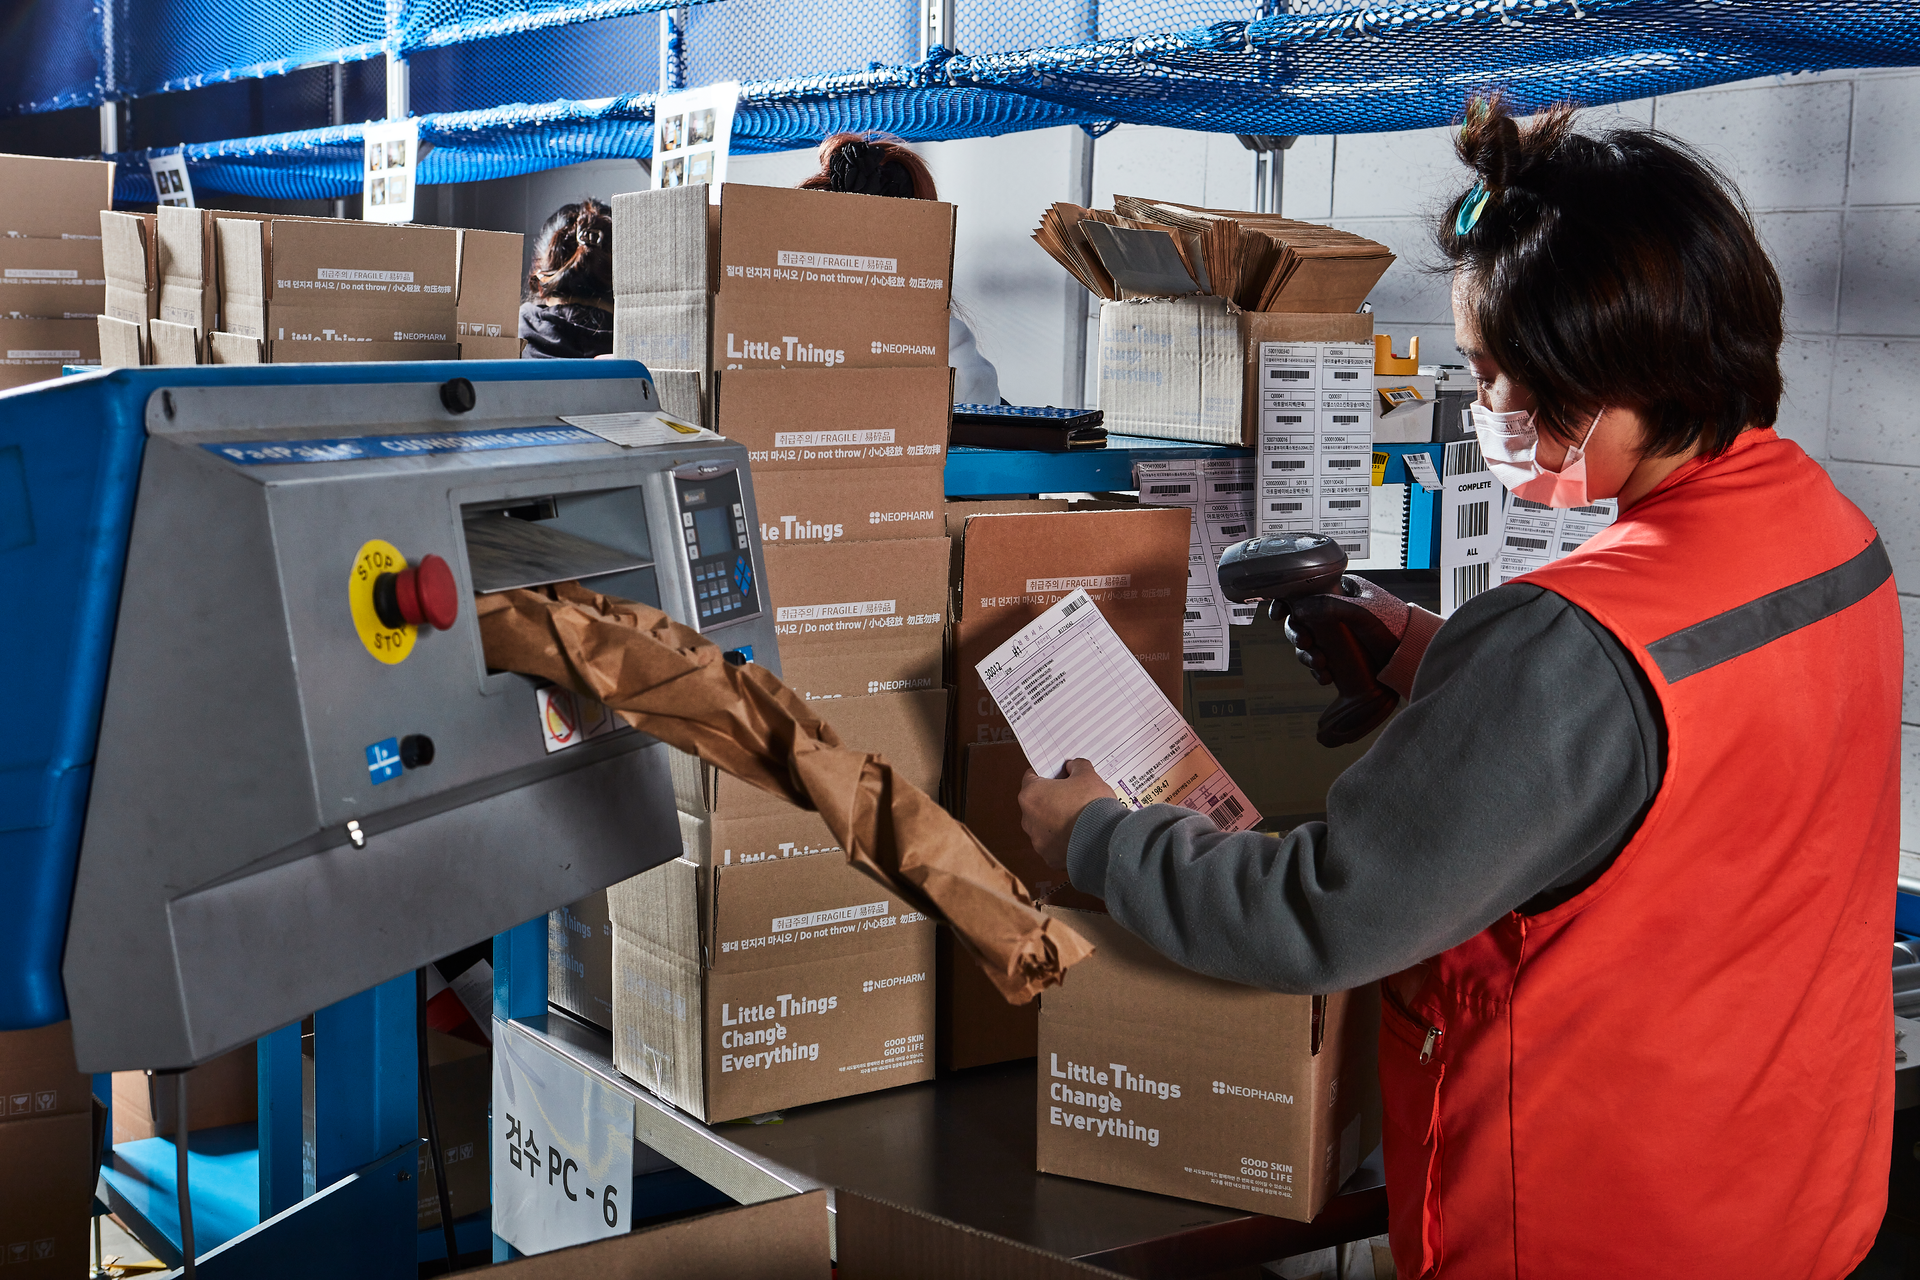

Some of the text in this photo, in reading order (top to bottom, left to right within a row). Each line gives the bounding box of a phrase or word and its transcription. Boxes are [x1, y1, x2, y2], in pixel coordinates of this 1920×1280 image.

[782, 253, 893, 271] 취급주의 FRAGILE 易碎品
[354, 272, 383, 280] FRAGILE
[726, 265, 744, 277] 절대
[746, 267, 771, 279] 던지지
[773, 268, 799, 280] 마시오
[806, 271, 819, 281] Do
[820, 272, 835, 282] not
[837, 272, 864, 284] throw
[277, 280, 291, 289] 절대
[292, 281, 313, 289] 던지지
[314, 281, 335, 290] 마시오
[365, 283, 387, 291] throw
[403, 332, 446, 341] NEOPHARM
[727, 333, 845, 367] Little Things
[882, 343, 936, 355] NEOPHARM
[779, 431, 891, 445] 취급주의 FRAGILE 易碎品
[770, 450, 796, 462] 마시오
[804, 450, 816, 460] Do
[817, 449, 833, 459] not
[834, 447, 861, 459] throw
[1458, 481, 1491, 492] COMPLETE
[881, 510, 934, 522] NEOPHARM
[780, 515, 843, 542] Things
[1467, 548, 1478, 557] ALL
[357, 551, 393, 581] STOP
[1029, 580, 1059, 590] 취급주의
[1066, 579, 1098, 588] FRAGILE
[980, 597, 996, 608] 절대
[998, 596, 1021, 607] 던지지
[1022, 595, 1045, 605] 마시오
[781, 602, 891, 619] 취급주의 FRAGILE 易碎品
[805, 623, 817, 633] Do
[819, 622, 834, 632] not
[835, 620, 862, 631] throw
[1011, 646, 1022, 658] H1
[1135, 651, 1170, 662] OPHARM
[984, 661, 1003, 680] 30012
[879, 678, 931, 691] NEOPHARM
[1211, 704, 1218, 715] 0
[1227, 703, 1234, 713] 0
[1141, 793, 1154, 805] 매탄
[562, 907, 592, 939] Things
[776, 916, 809, 930] 취급주의
[816, 909, 852, 924] FRAGILE
[721, 941, 739, 953] 절대
[740, 936, 766, 950] 던지지
[767, 933, 793, 945] 마시오
[800, 930, 813, 940] Do
[813, 928, 829, 938] not
[830, 924, 856, 936] throw
[874, 972, 925, 990] NEOPHARM
[721, 993, 837, 1027] Little Things
[721, 1022, 787, 1049] Change
[884, 1034, 924, 1048] GOOD SKIN
[721, 1042, 819, 1073] Everything
[884, 1042, 924, 1057] GOOD LIFE
[1050, 1052, 1181, 1100] Little Things
[1050, 1082, 1122, 1113] Change
[1226, 1084, 1294, 1105] NEOPHARM
[1050, 1106, 1160, 1147] Everything
[506, 1112, 618, 1228] 검수 PC - 6
[1240, 1157, 1293, 1173] GOOD SKIN
[1240, 1166, 1293, 1183] GOOD LIFE
